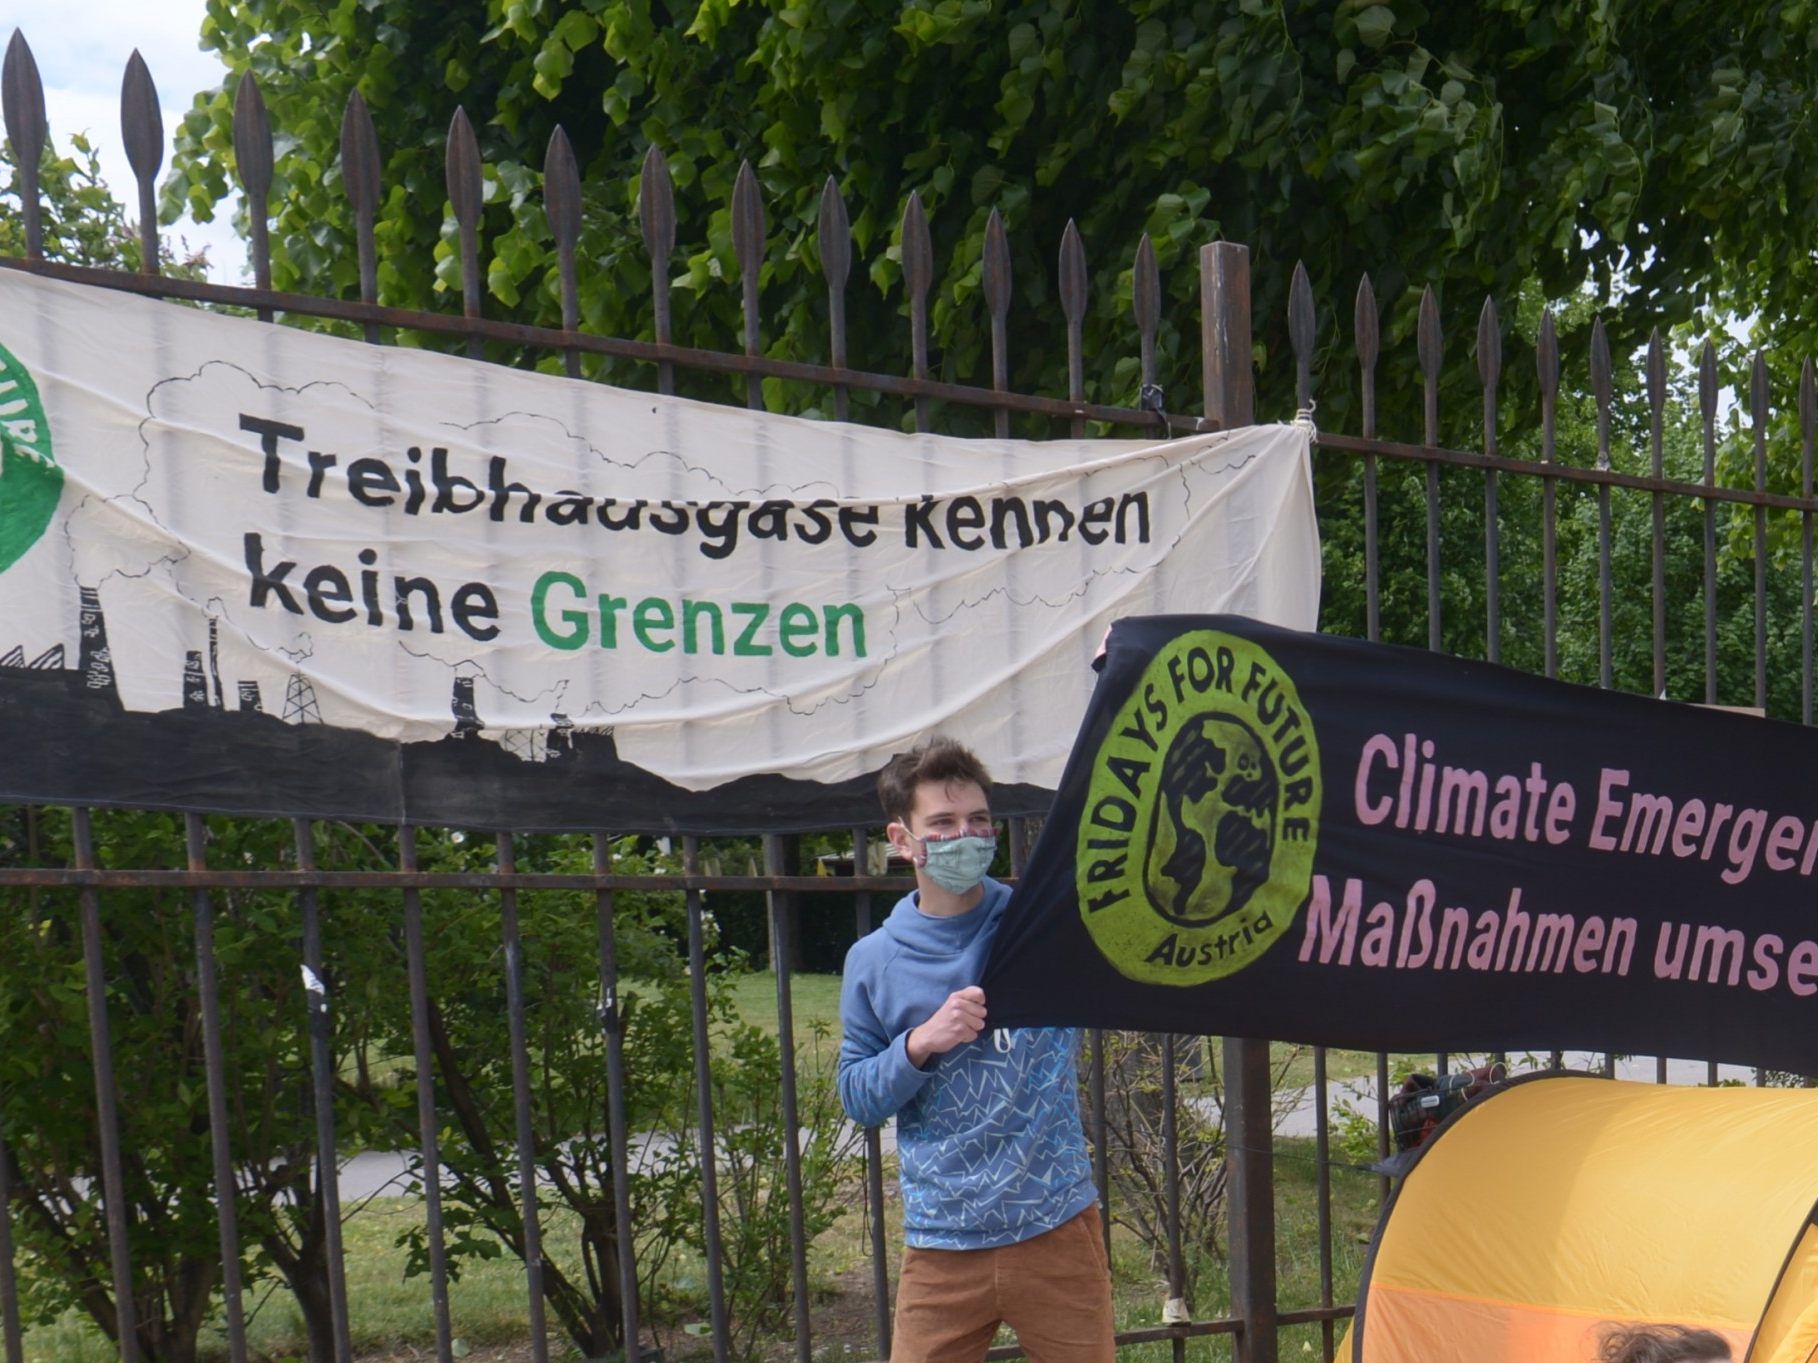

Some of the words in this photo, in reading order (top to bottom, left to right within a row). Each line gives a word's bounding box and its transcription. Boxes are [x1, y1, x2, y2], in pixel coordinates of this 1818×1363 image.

[239, 413, 879, 560] Treibhausgase
[905, 490, 1150, 552] kennen
[244, 533, 501, 642] keine
[531, 571, 867, 658] Grenzen
[1087, 683, 1168, 914] FRIDAYS
[1167, 646, 1235, 704] FOR
[1240, 661, 1314, 842] FUTURE
[1355, 733, 1577, 845] Climate
[1144, 910, 1274, 968] Austria
[1297, 874, 1638, 976] Maßnahmen
